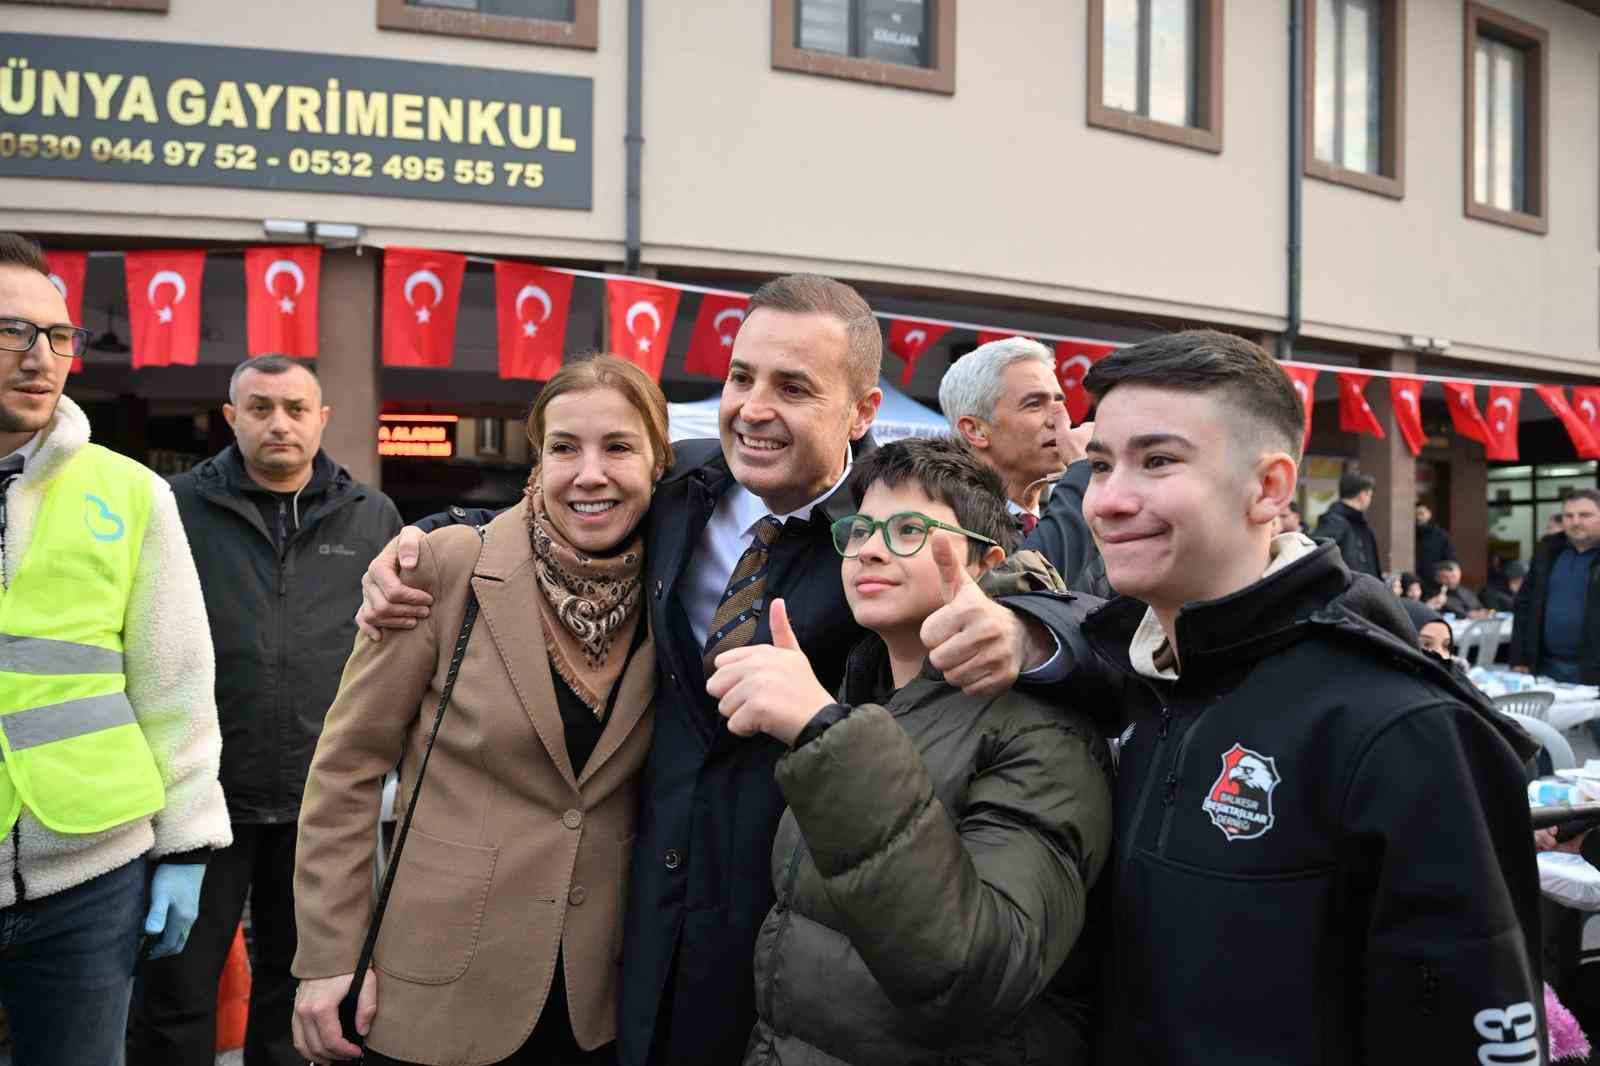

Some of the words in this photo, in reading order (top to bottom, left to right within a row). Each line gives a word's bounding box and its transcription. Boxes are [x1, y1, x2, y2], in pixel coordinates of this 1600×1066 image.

[0, 57, 159, 123] ÜNYA
[166, 77, 577, 153] GAYRİMENKUL
[0, 131, 81, 160] 0530
[91, 136, 154, 165] 044
[163, 140, 206, 167] 97
[214, 143, 257, 170] 52
[288, 147, 373, 177] 0532
[381, 154, 445, 182] 495
[454, 159, 495, 185] 55
[503, 162, 544, 188] 75
